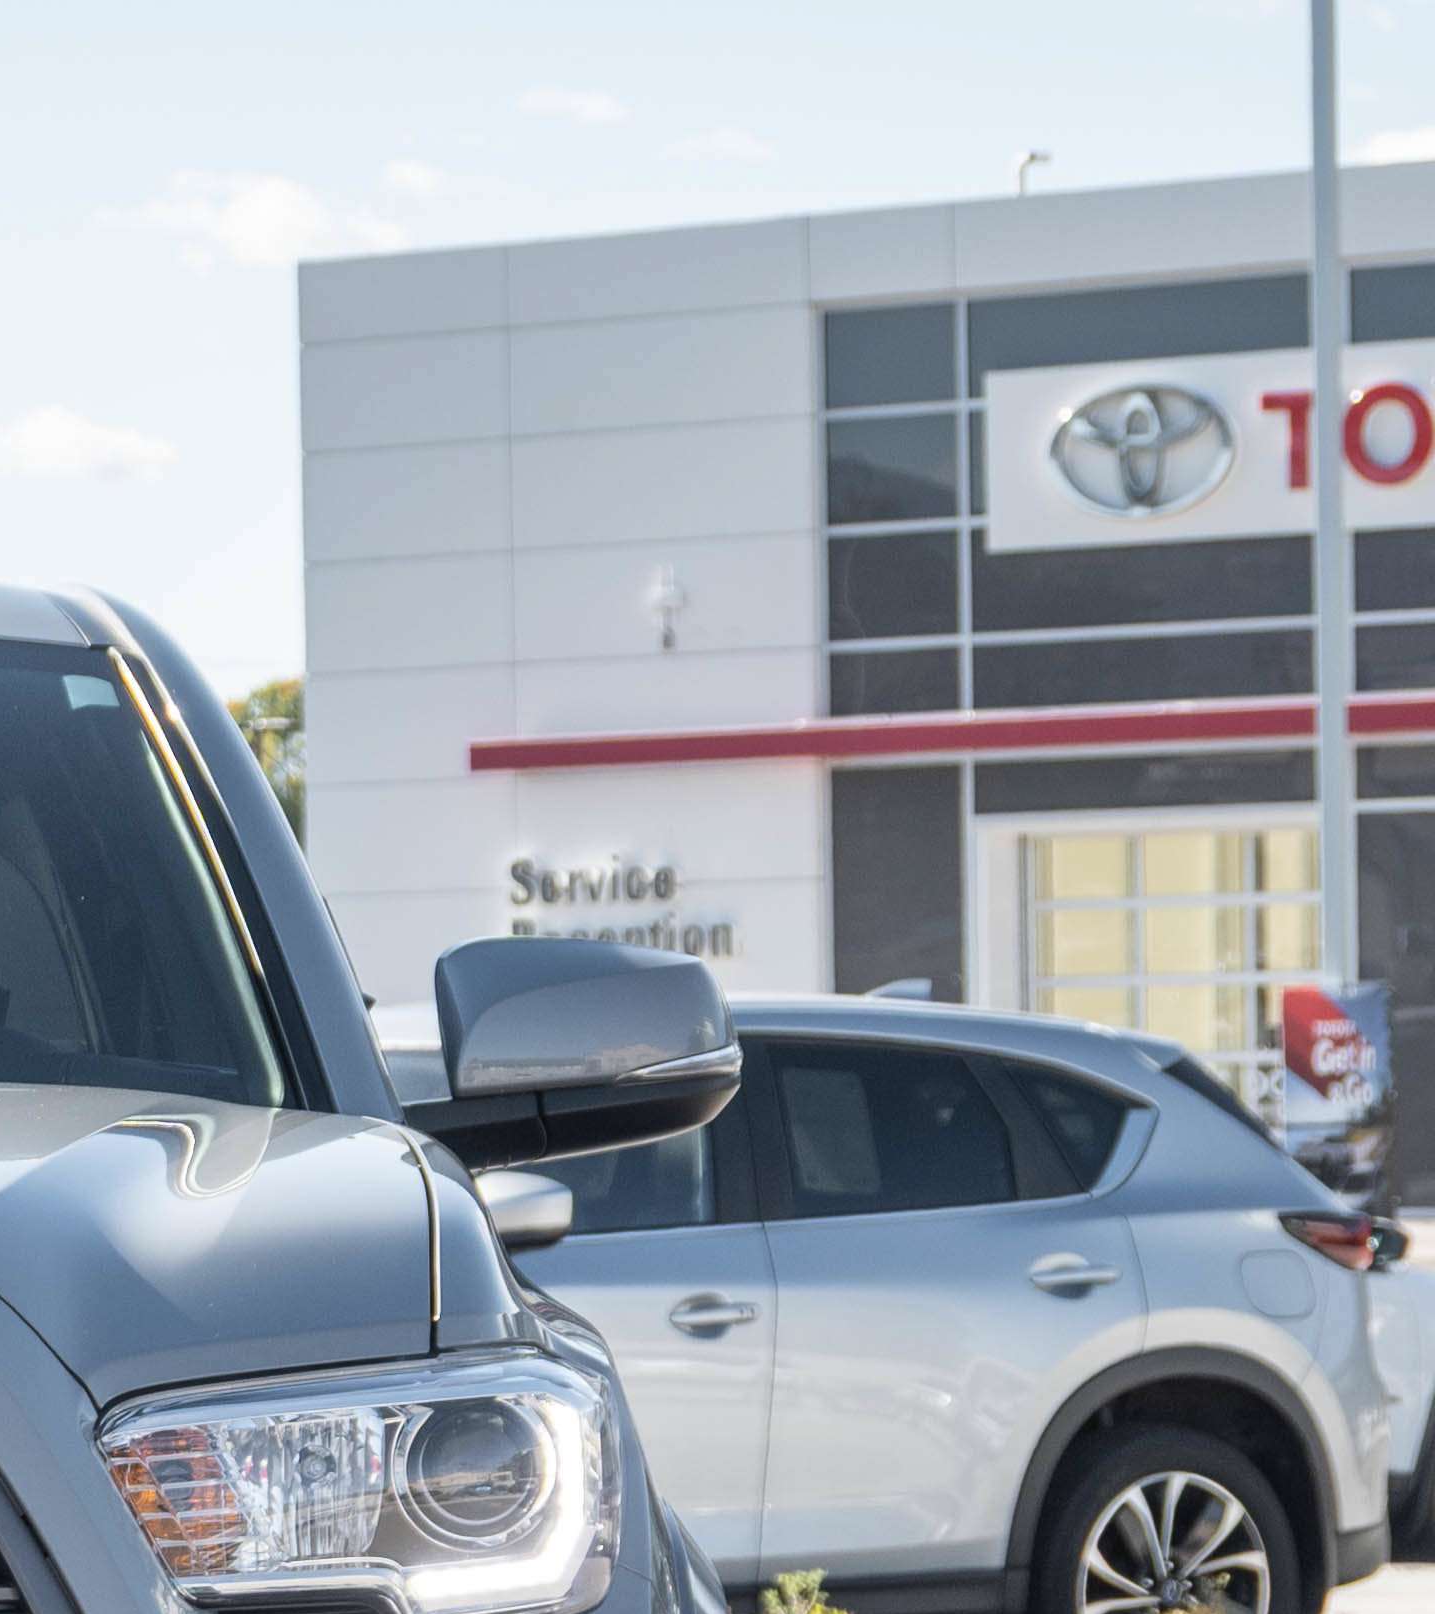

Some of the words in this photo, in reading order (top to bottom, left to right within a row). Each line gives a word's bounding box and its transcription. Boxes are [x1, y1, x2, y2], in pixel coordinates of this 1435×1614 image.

[510, 854, 677, 904] Service
[1311, 1038, 1358, 1076] Get
[1360, 1035, 1377, 1072] in
[1345, 1072, 1373, 1104] Go
